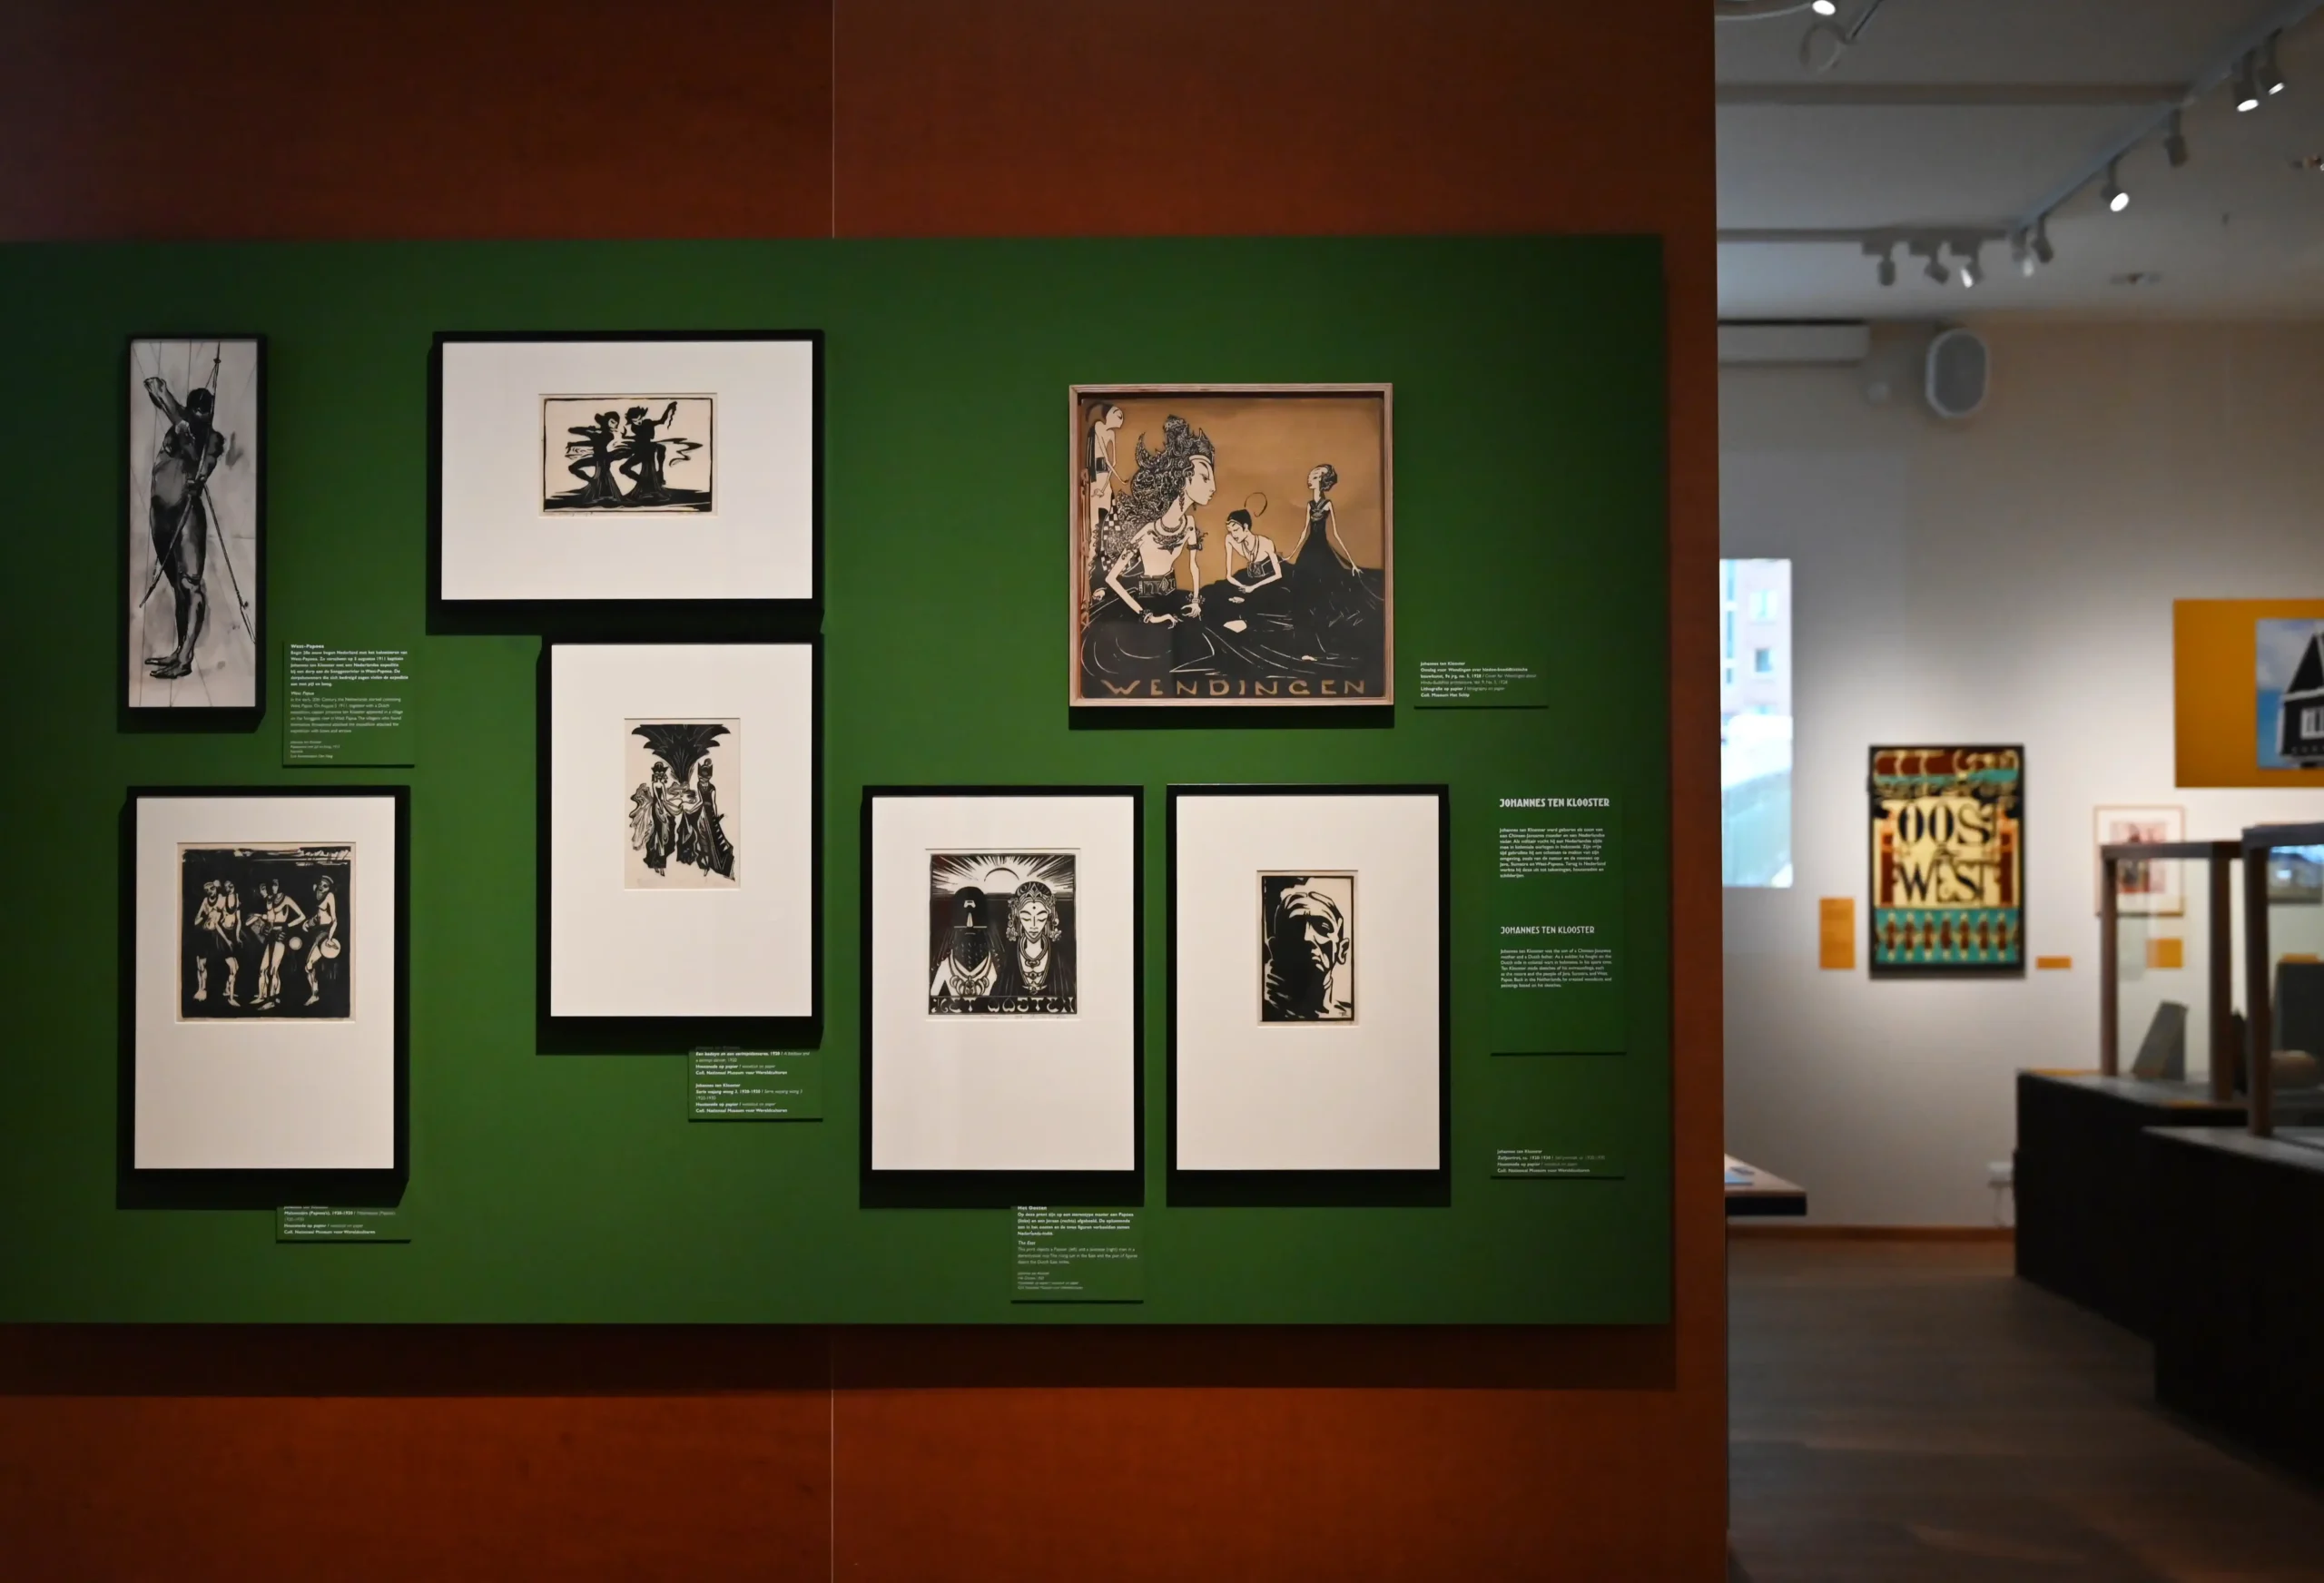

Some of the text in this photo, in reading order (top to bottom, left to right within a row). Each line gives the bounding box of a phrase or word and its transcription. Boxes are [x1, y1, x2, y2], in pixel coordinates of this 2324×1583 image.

[1100, 680, 1364, 696] WENDINGEN
[1500, 798, 1610, 808] JOHANNES TEN KLOOSTER
[1501, 926, 1594, 934] JOHANNES TEN KLOOSTER
